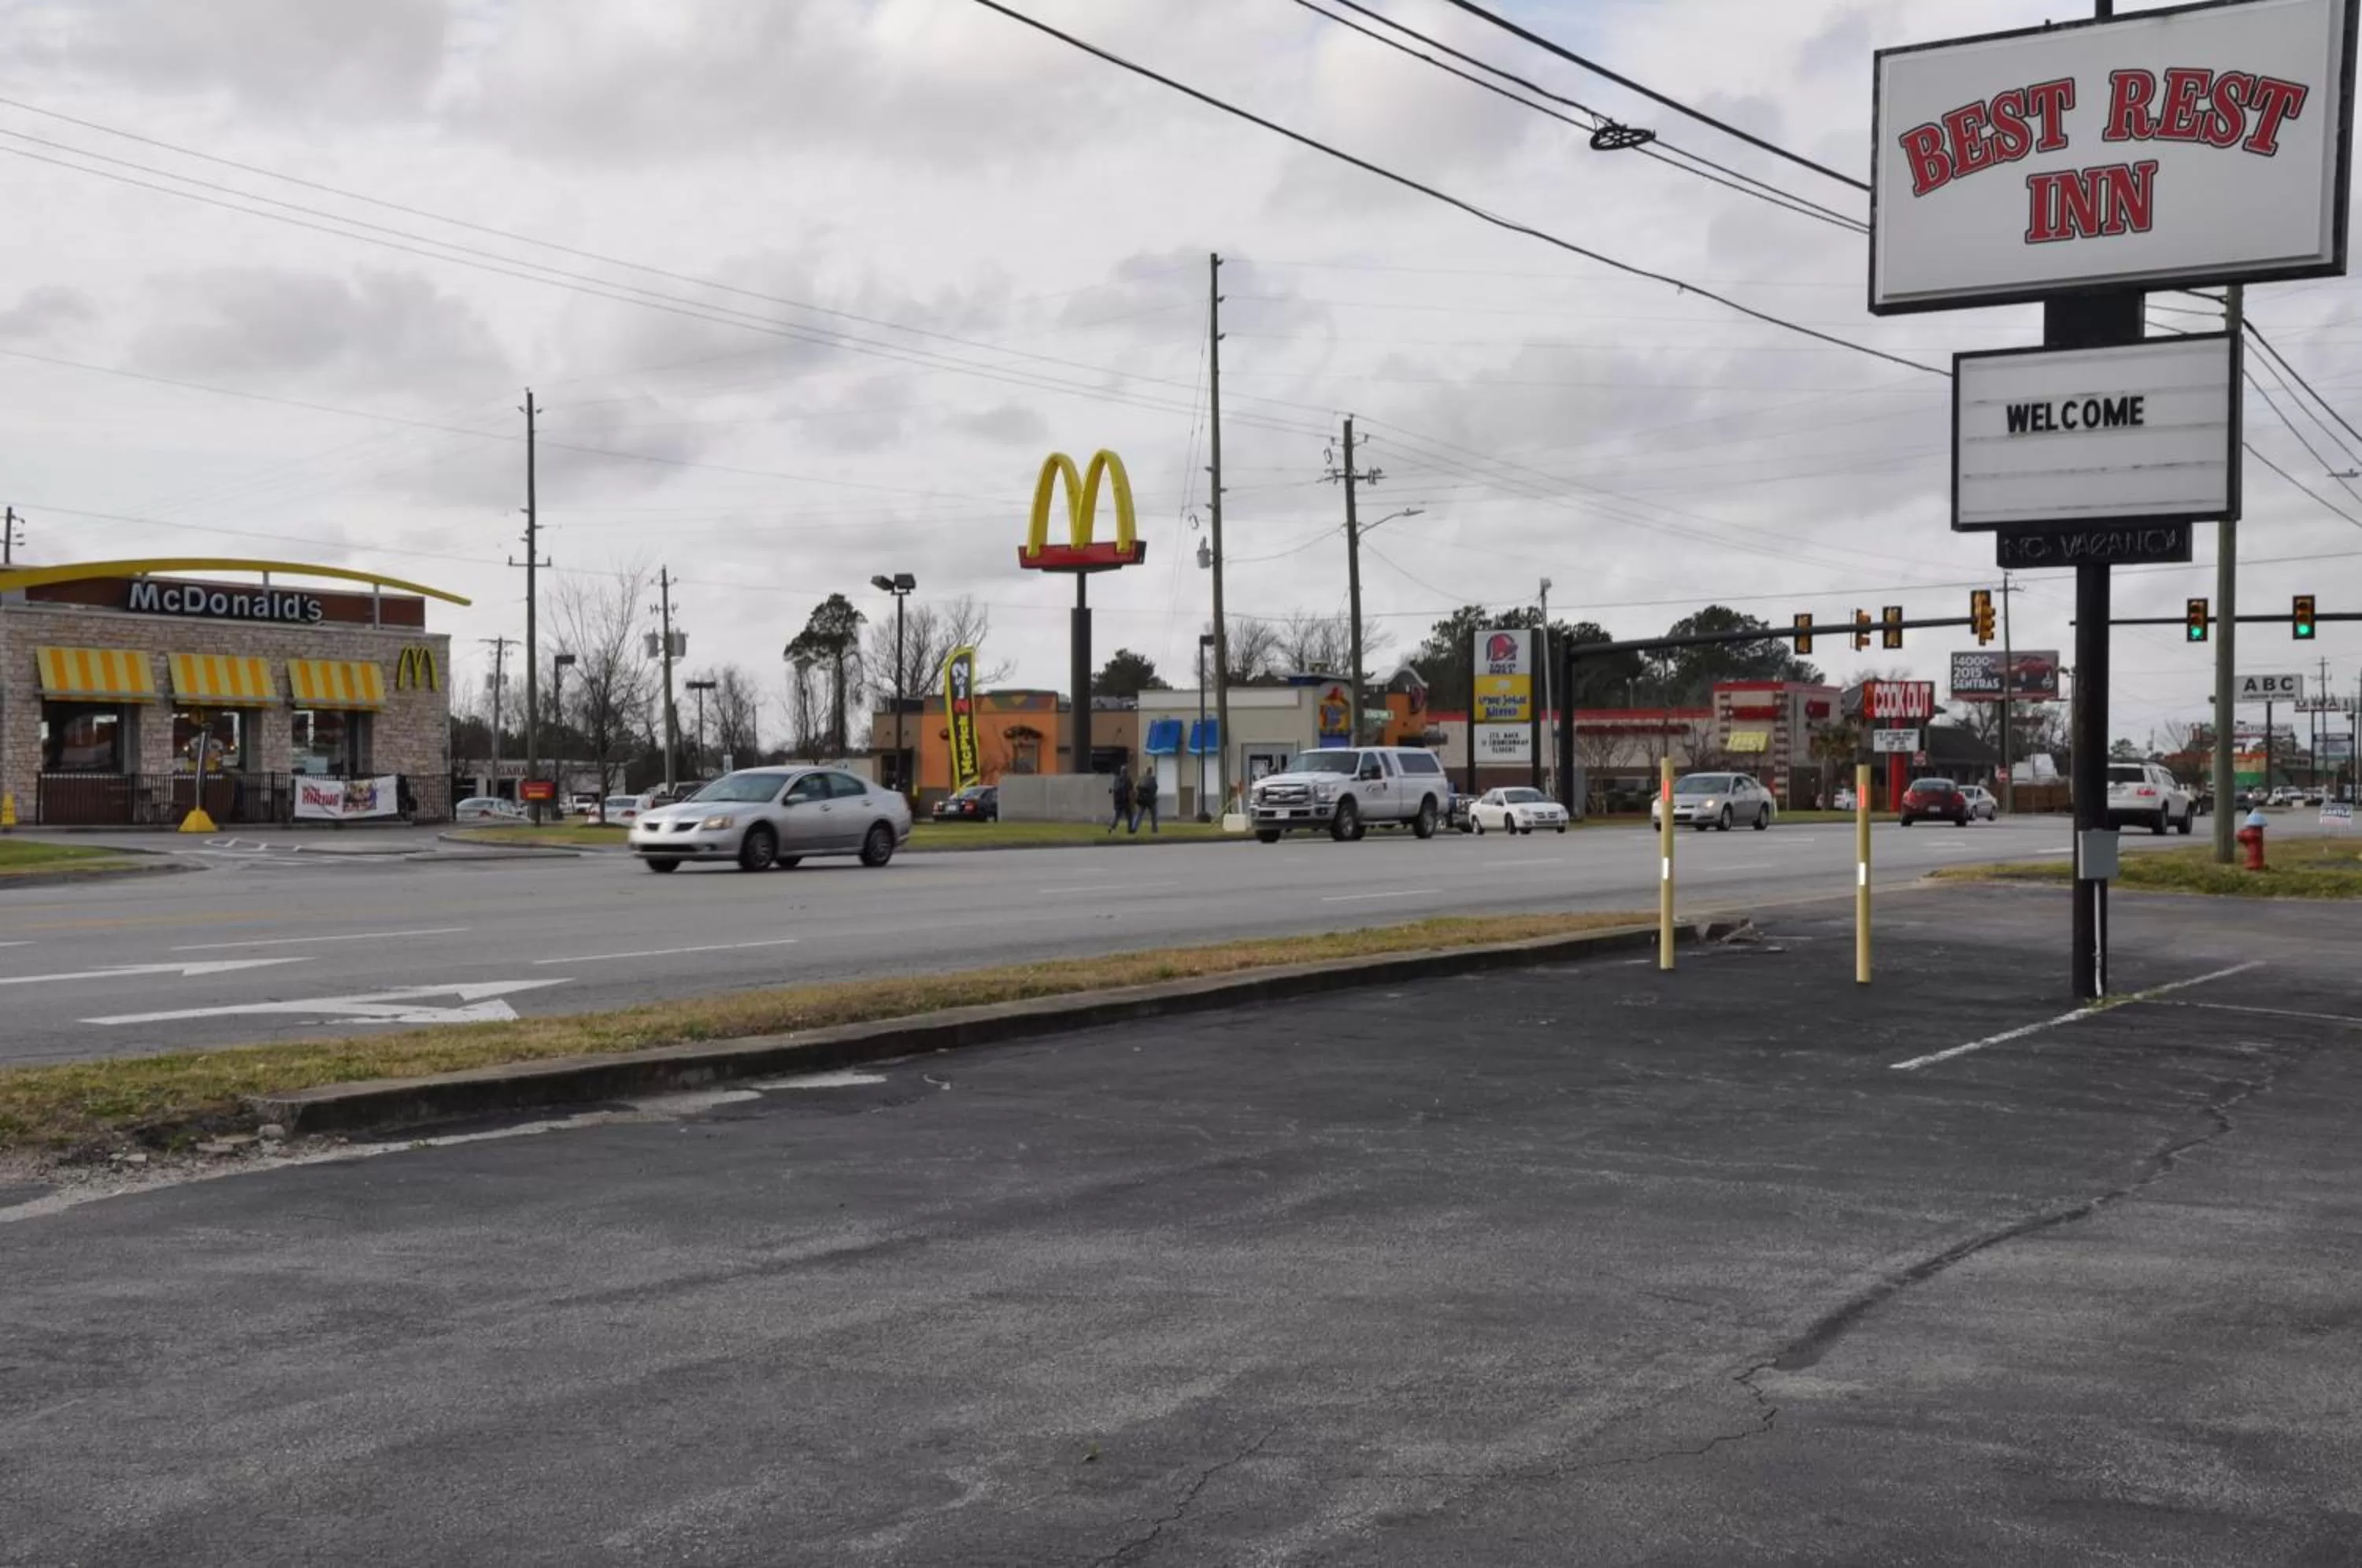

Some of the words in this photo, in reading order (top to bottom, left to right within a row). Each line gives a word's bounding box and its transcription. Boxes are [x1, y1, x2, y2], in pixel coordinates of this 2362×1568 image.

[1899, 78, 2075, 197] BEST
[2102, 67, 2308, 156] REST
[2025, 160, 2158, 243] INN
[2007, 396, 2144, 433] WELCOME
[2004, 536, 2047, 559] NO
[2060, 529, 2182, 558] VACANCY
[128, 582, 323, 620] McDonald's
[1953, 667, 1983, 678] 2015
